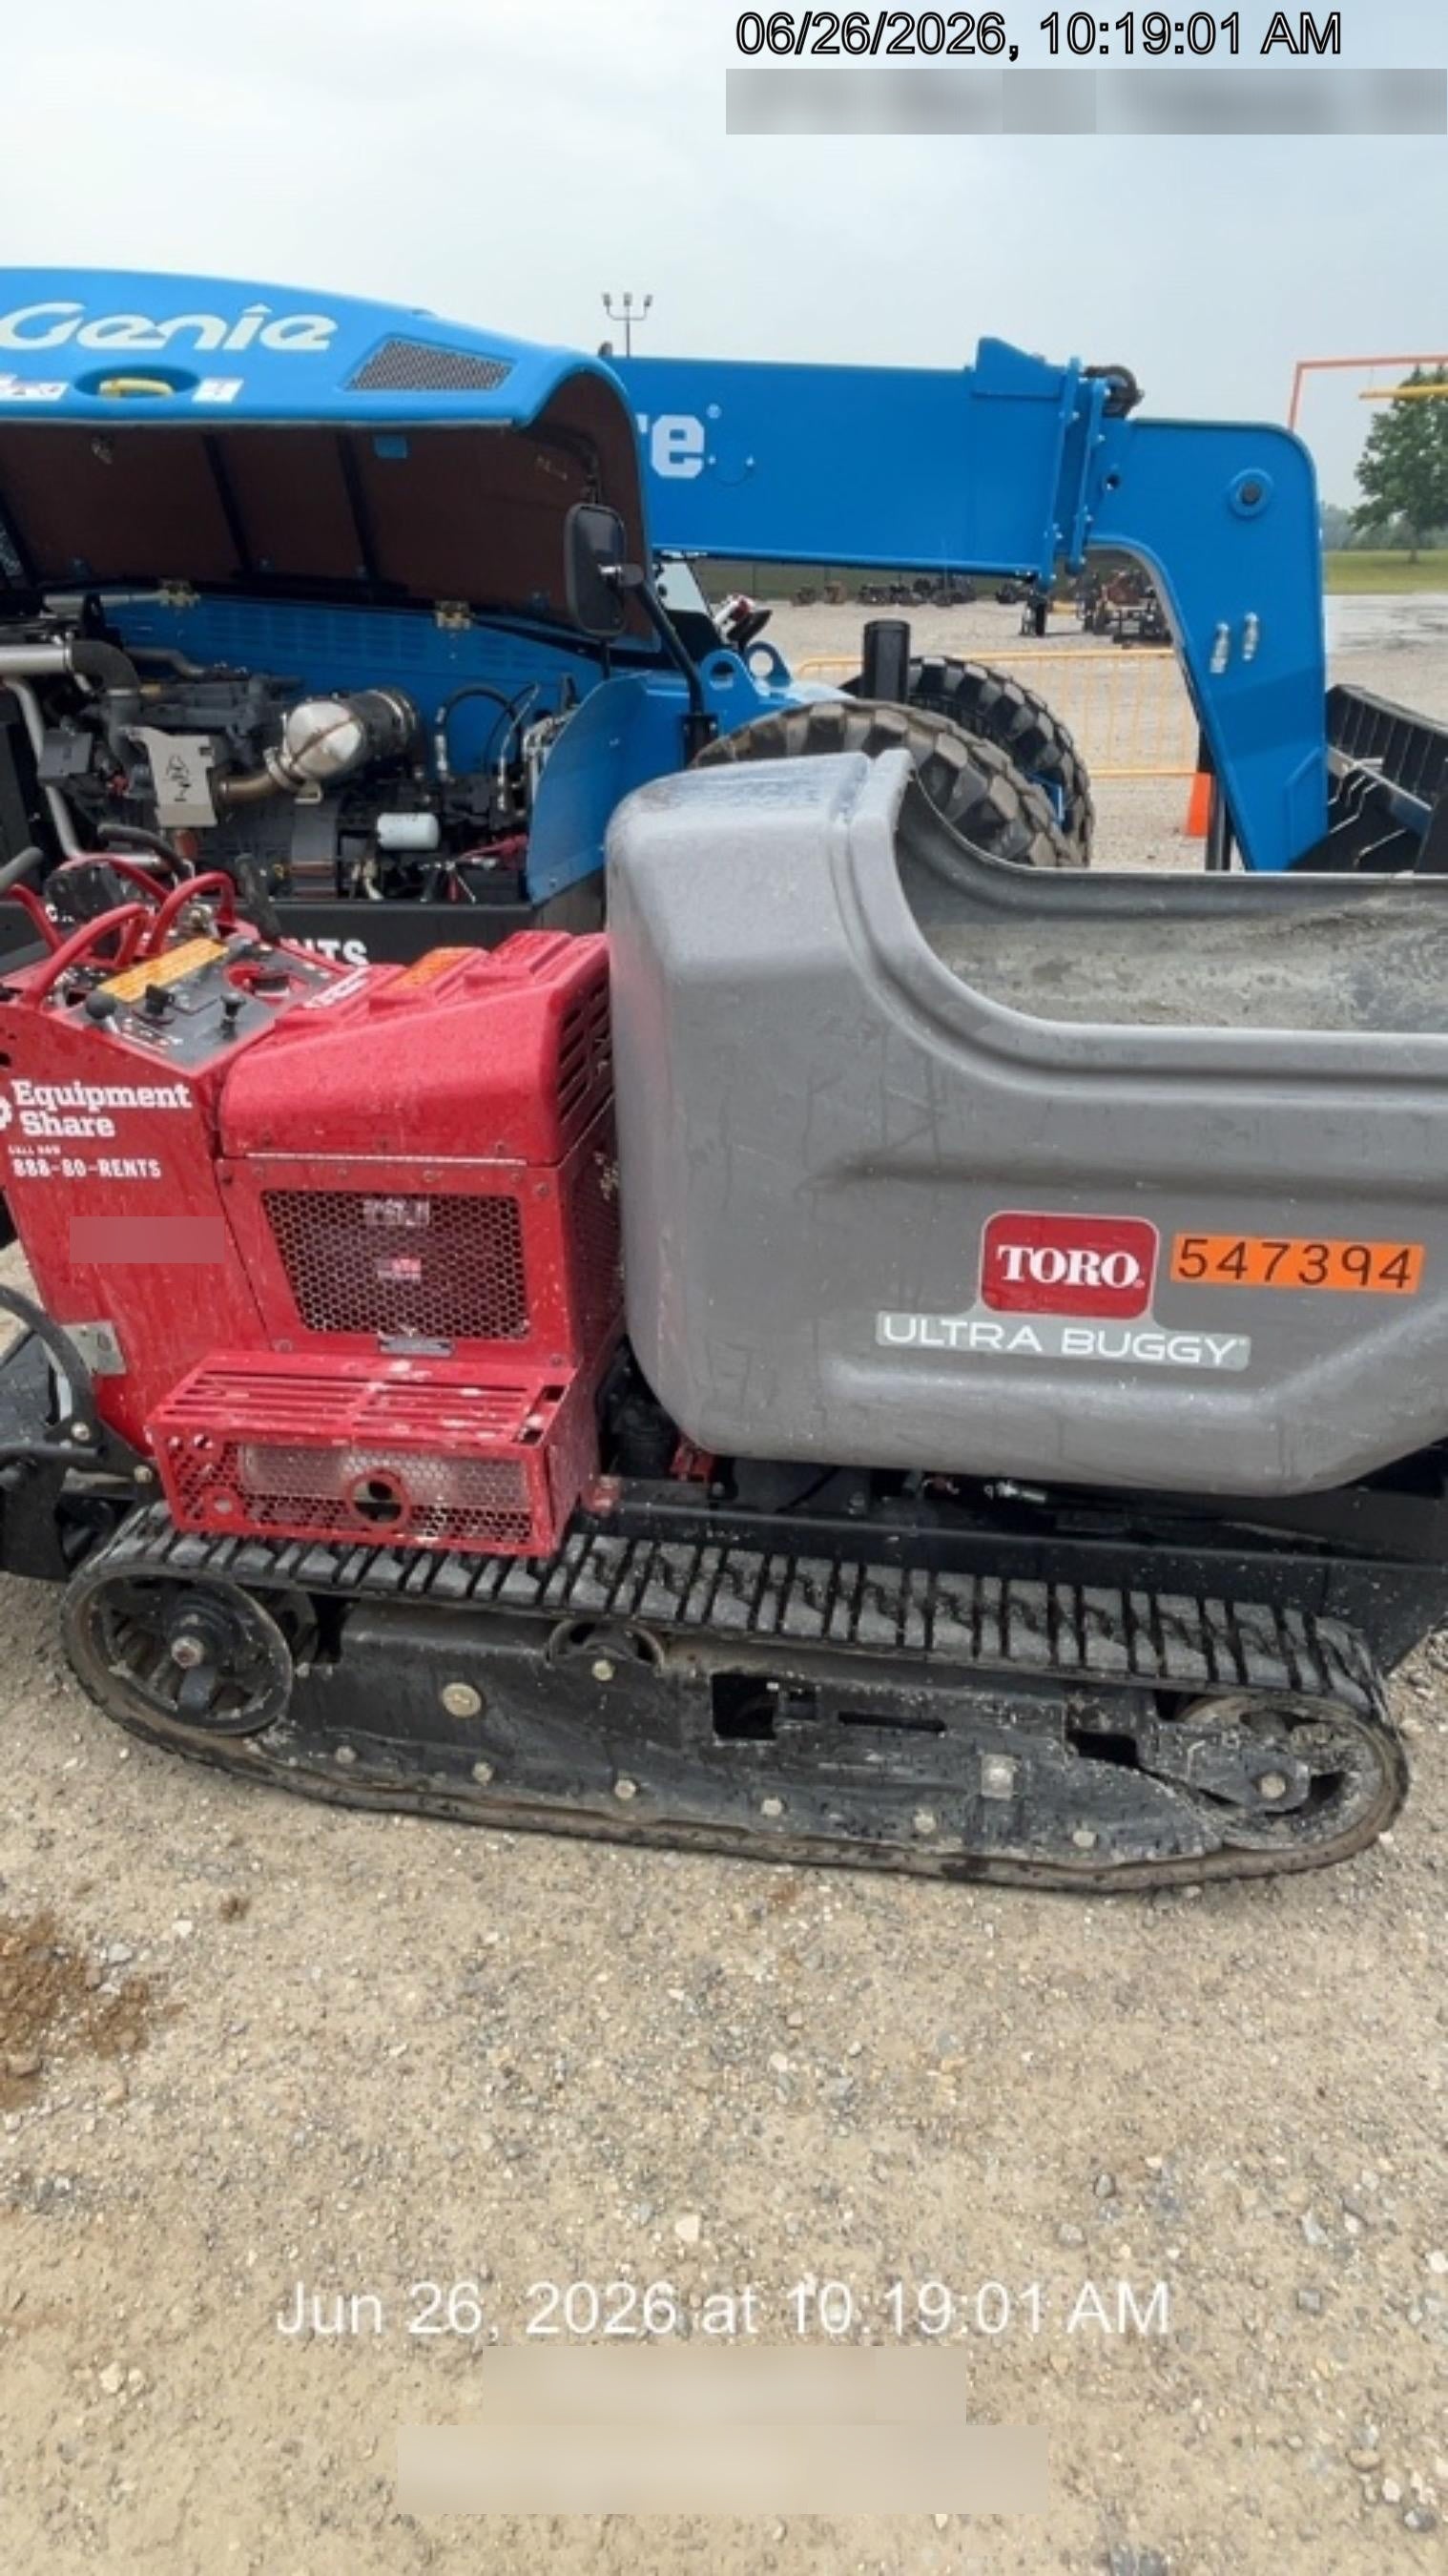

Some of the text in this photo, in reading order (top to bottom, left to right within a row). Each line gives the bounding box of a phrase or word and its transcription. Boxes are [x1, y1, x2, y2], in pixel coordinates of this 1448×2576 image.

[10, 1080, 193, 1113] Equipment
[19, 1110, 115, 1137] Share
[12, 1158, 161, 1178] 888-80-RENTS
[1178, 1238, 1412, 1289] 547394
[882, 1316, 1239, 1366] ULTRA BUGGY
